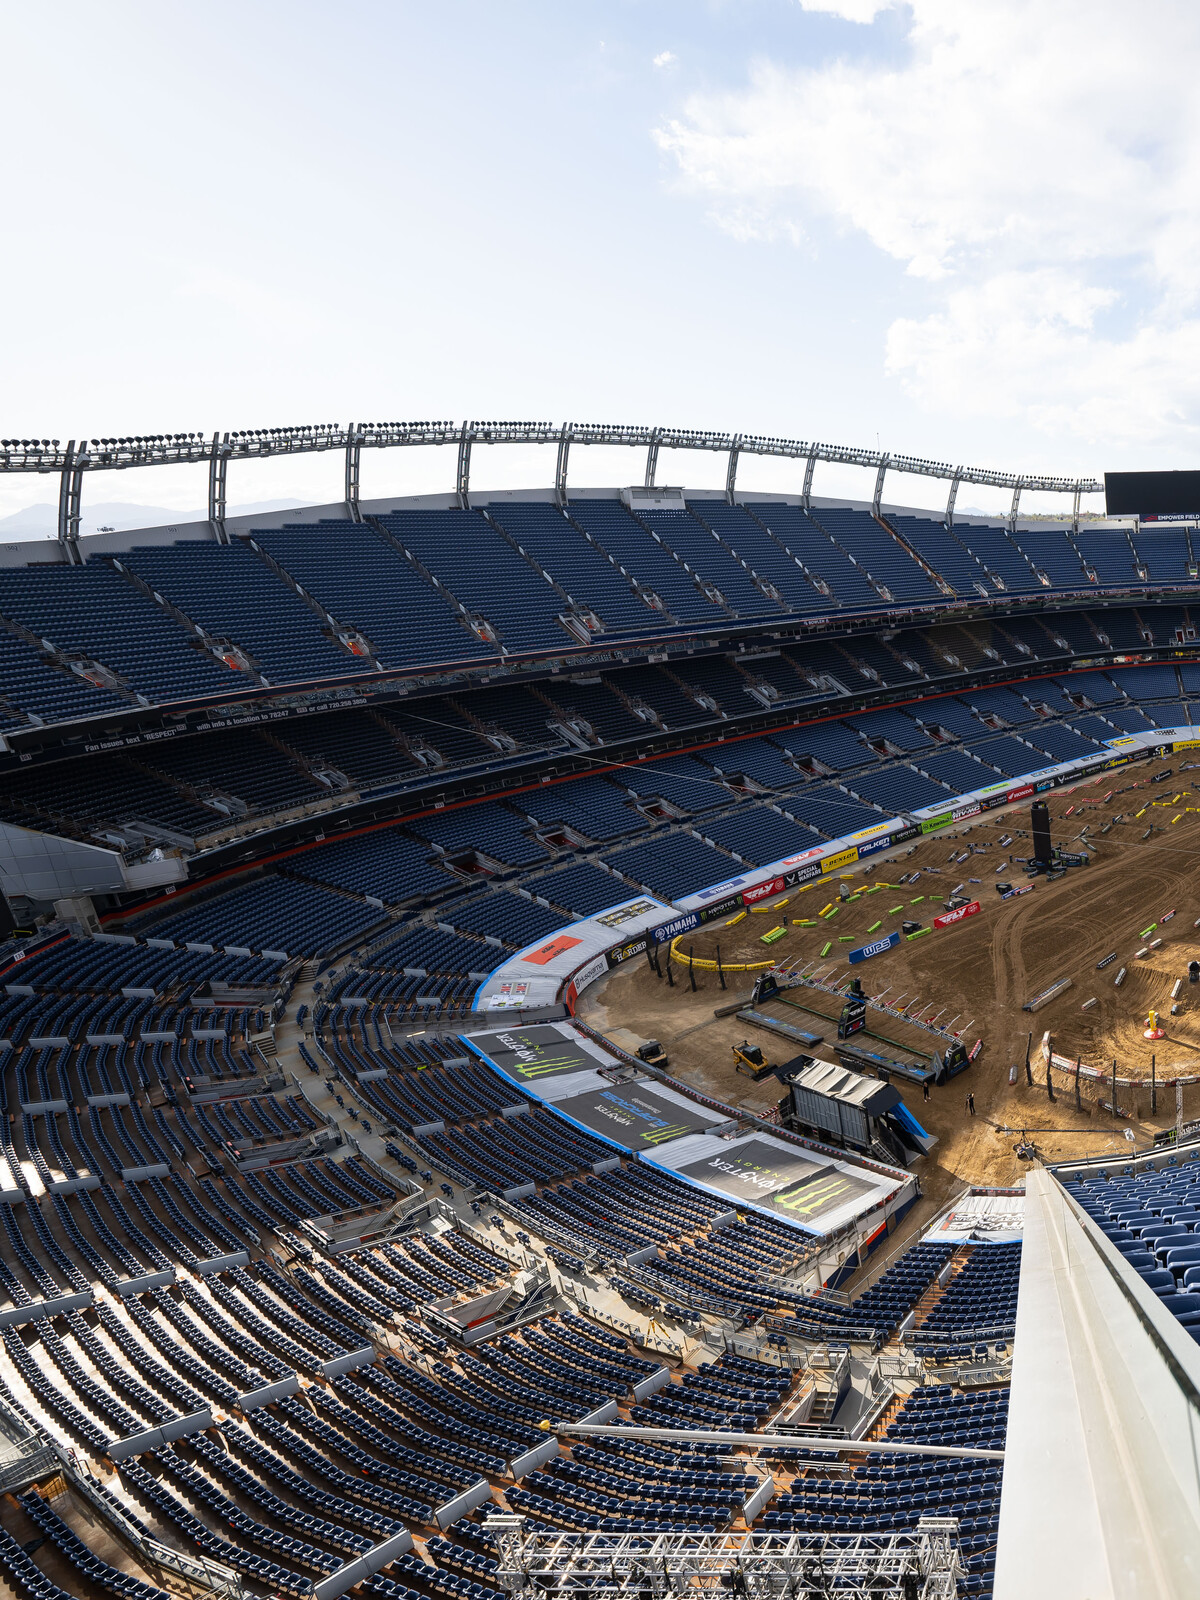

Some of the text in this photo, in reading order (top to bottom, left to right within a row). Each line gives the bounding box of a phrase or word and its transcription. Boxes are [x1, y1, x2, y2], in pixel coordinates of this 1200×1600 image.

[352, 698, 367, 706] 3850
[197, 722, 211, 731] with
[212, 719, 225, 728] info
[233, 715, 260, 725] location
[269, 710, 289, 719] 78247
[85, 742, 100, 752] Fan
[100, 740, 124, 750] issues
[126, 736, 140, 744] text
[1014, 788, 1032, 798] HONDA
[929, 816, 952, 828] Kawasaki
[860, 837, 890, 853] FALKEN
[829, 852, 857, 866] DUNLOP
[798, 865, 818, 876] SPECIAL
[799, 869, 821, 882] WARFARE
[166, 887, 175, 895] 100
[744, 882, 774, 898] FLY
[708, 900, 736, 915] MONSTER
[938, 907, 966, 923] FLY
[664, 915, 697, 934] YAMAHA
[542, 944, 556, 954] KTM
[617, 941, 647, 962] HARDER
[863, 937, 892, 957] WPS
[496, 1033, 538, 1062] MOSTER
[518, 1036, 545, 1054] ENRGY
[594, 1104, 633, 1126] MONSTER
[600, 1091, 670, 1128] SUPERCROSS
[708, 1158, 786, 1193] MONSTER
[734, 1159, 790, 1182] ENERGY
